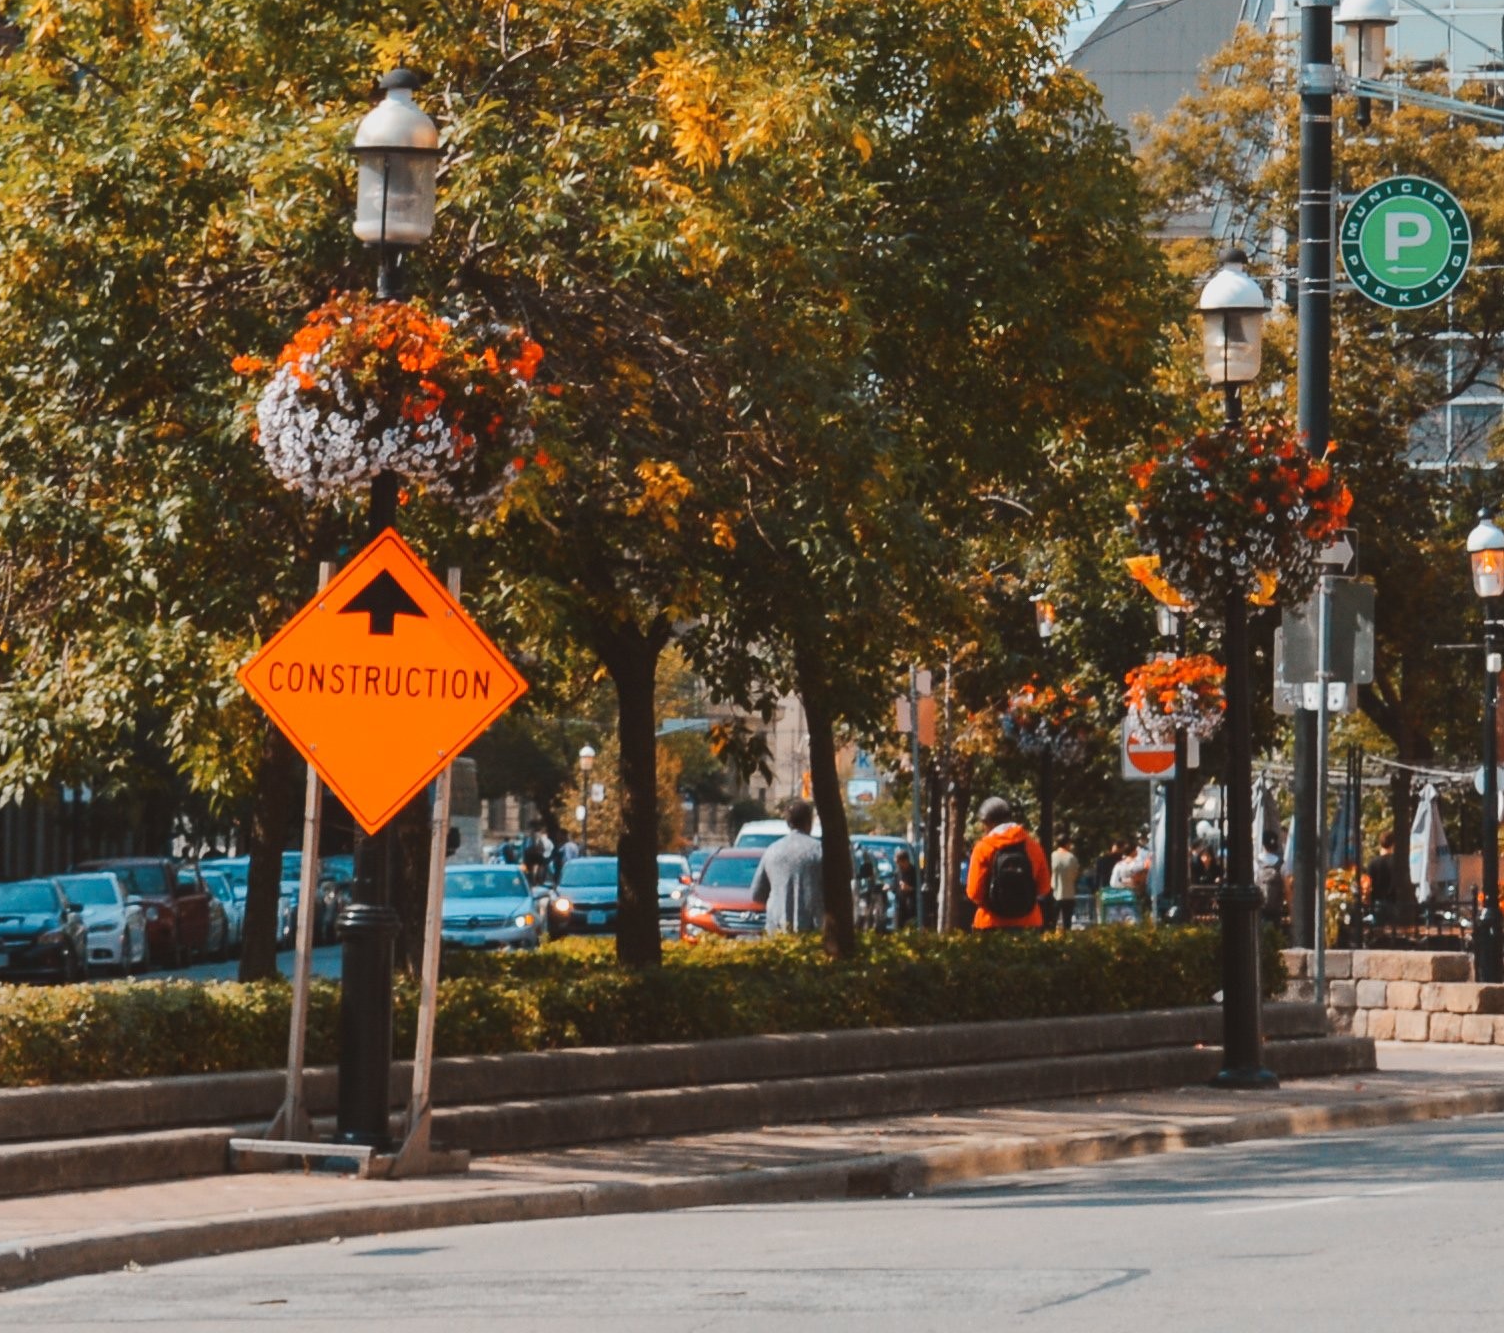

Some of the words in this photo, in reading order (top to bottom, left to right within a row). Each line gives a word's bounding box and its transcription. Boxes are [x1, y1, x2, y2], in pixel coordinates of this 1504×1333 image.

[1347, 183, 1462, 237] MUNICIPAL
[1384, 212, 1432, 261] P
[1348, 254, 1462, 304] PARKING
[269, 661, 491, 700] CONSTRUCTION
